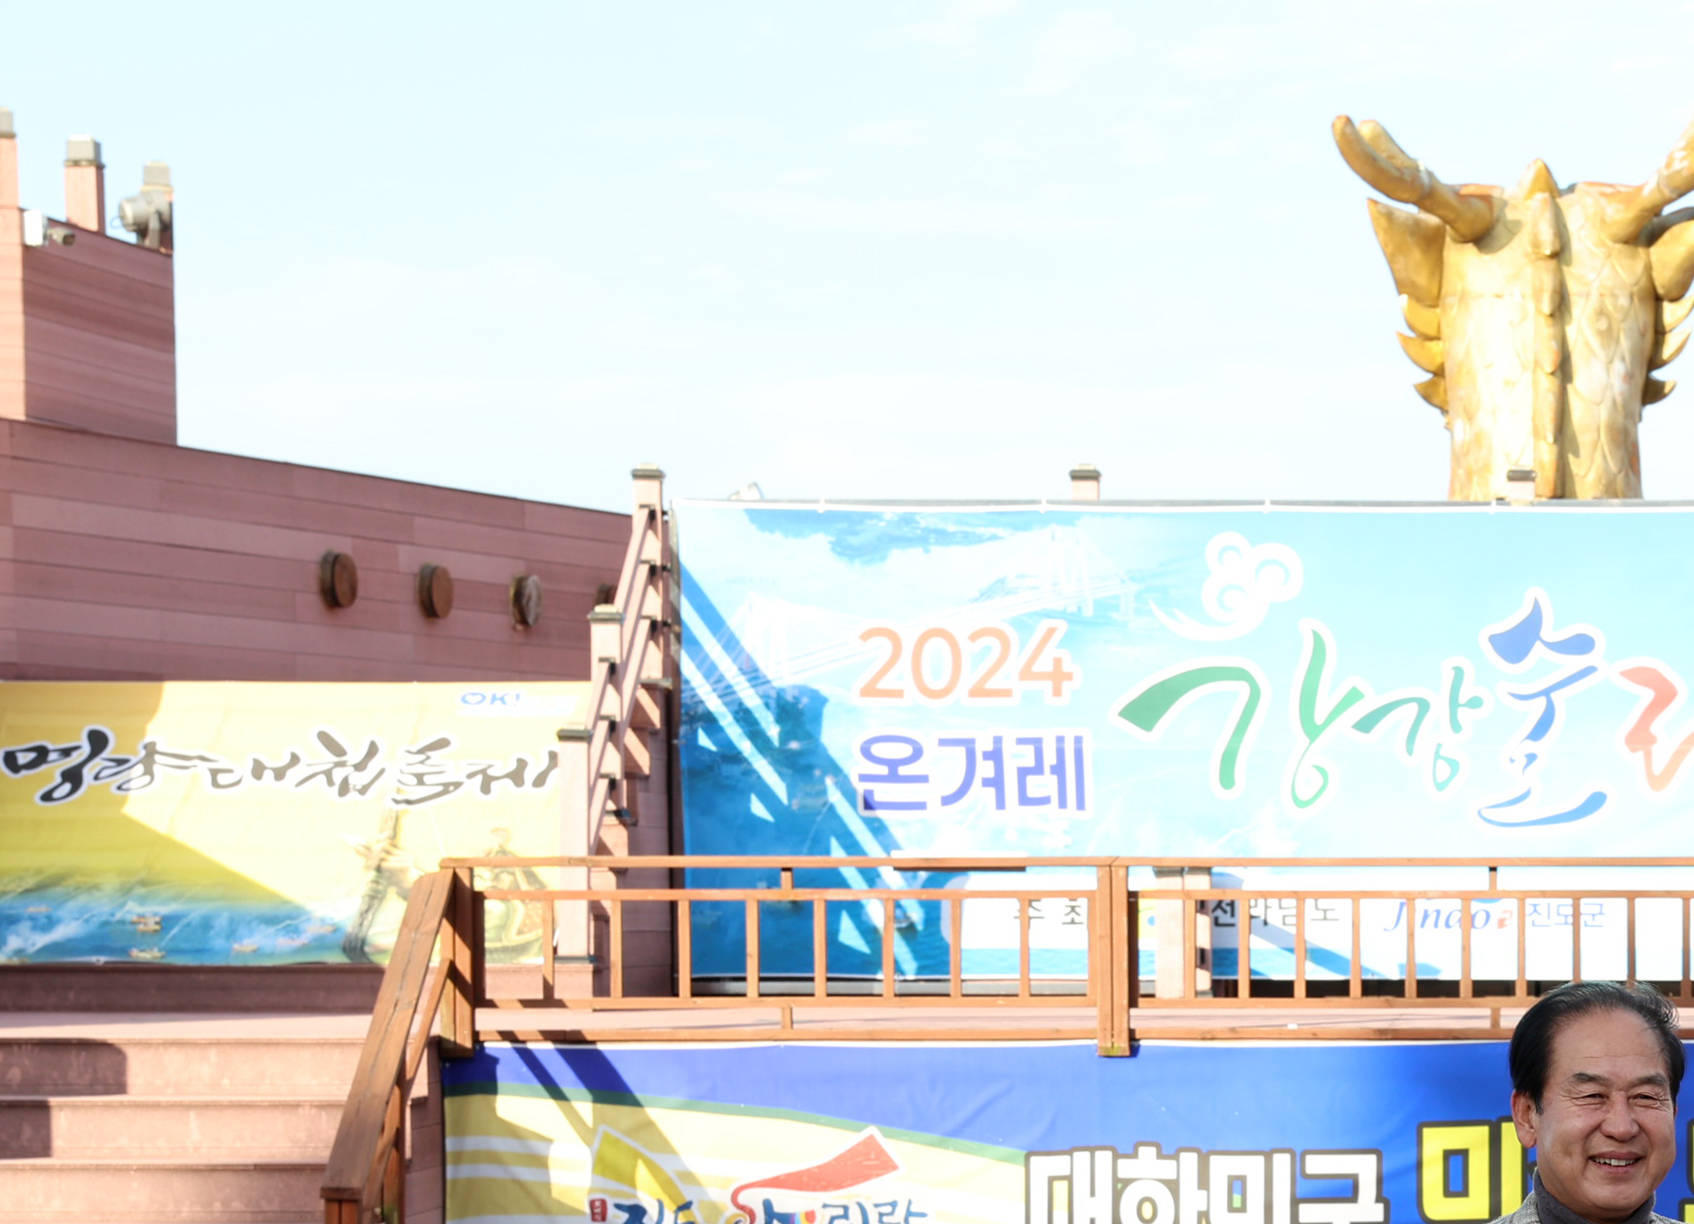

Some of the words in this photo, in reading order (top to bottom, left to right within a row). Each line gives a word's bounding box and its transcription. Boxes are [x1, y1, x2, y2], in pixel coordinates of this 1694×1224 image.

[460, 692, 520, 706] OK!
[858, 625, 1074, 700] 2024
[857, 733, 1087, 812] 온겨레
